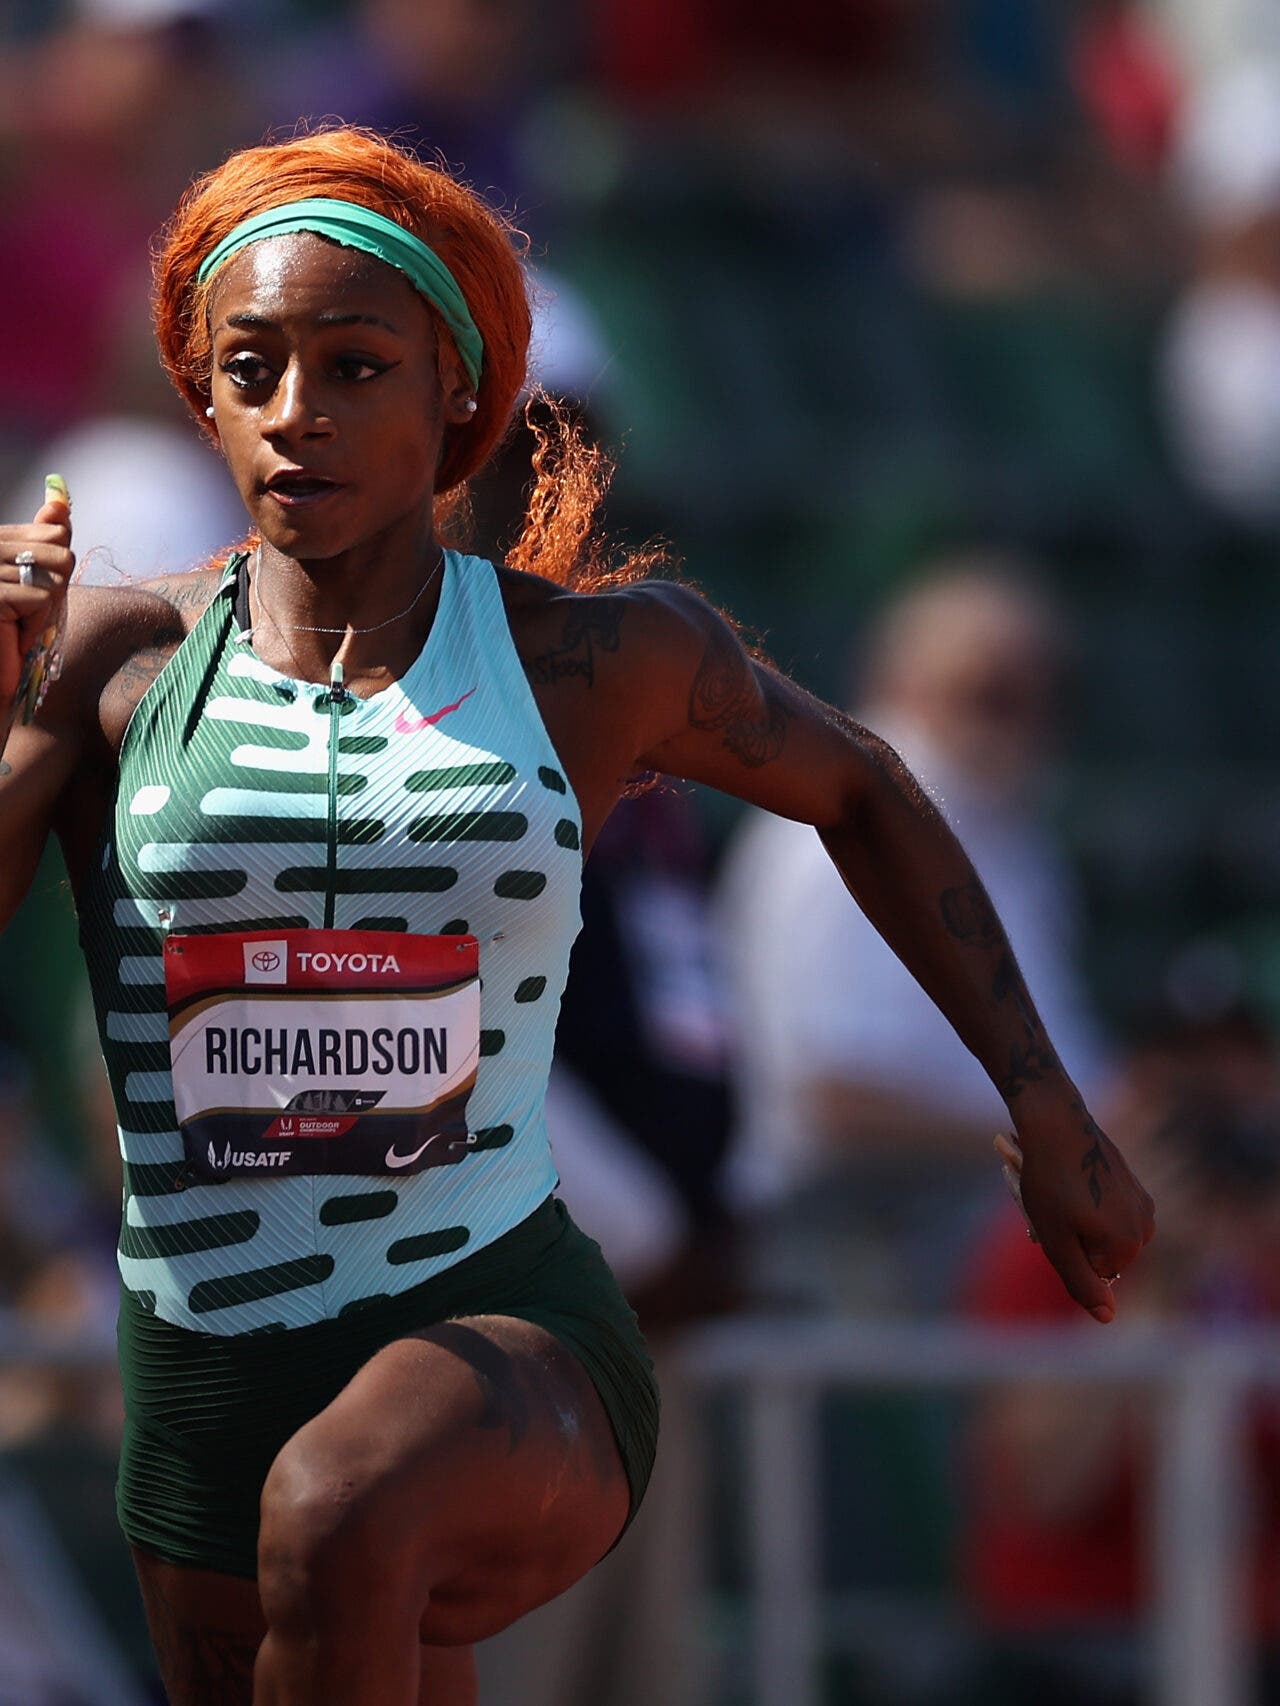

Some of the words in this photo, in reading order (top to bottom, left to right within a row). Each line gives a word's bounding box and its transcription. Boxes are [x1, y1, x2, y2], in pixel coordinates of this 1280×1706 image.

[296, 952, 401, 974] TOYOTA
[205, 1027, 448, 1076] RICHARDSON
[232, 1151, 292, 1168] USATF
